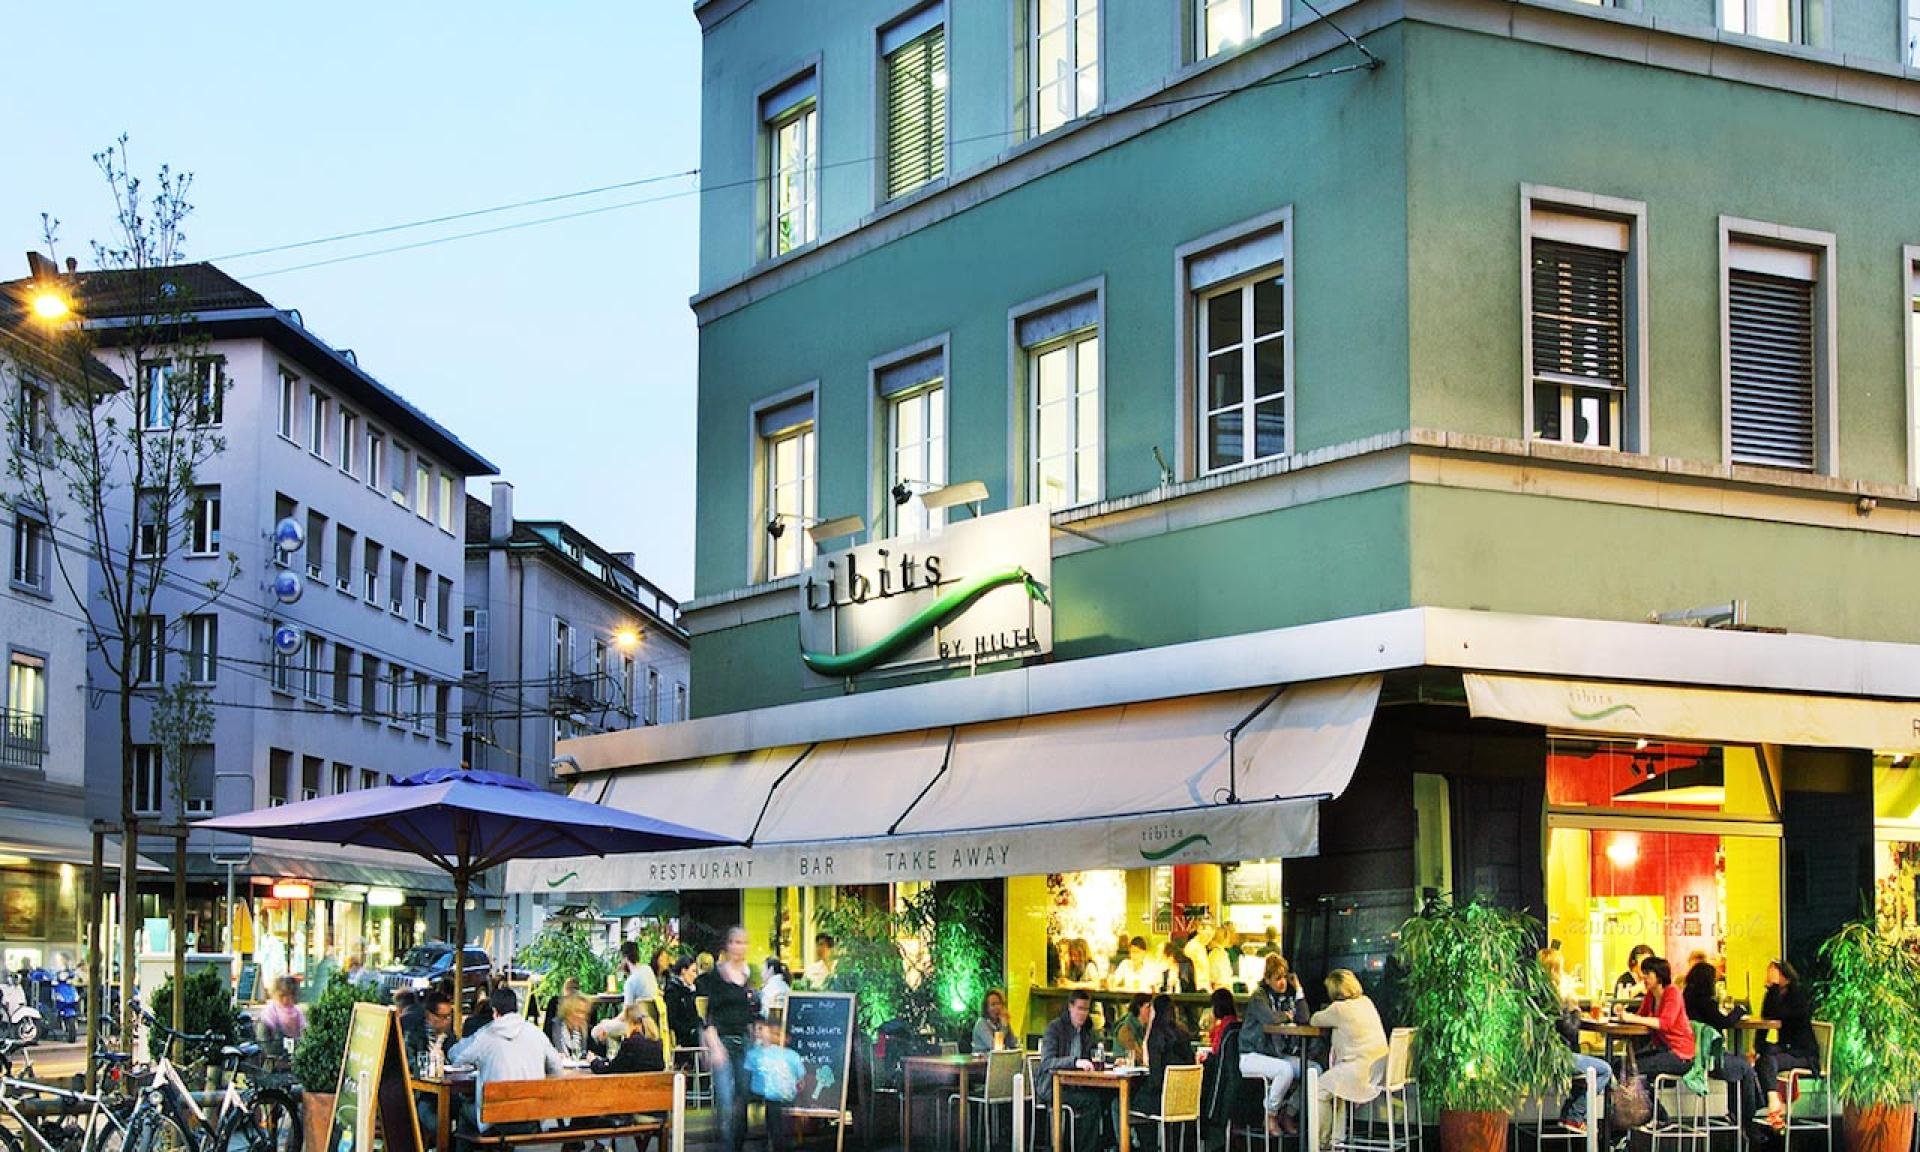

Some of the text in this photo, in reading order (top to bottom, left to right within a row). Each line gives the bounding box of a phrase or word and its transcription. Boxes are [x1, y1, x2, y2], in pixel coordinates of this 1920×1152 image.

[804, 548, 943, 610] tibits
[939, 627, 1039, 659] BY HILTL
[1142, 824, 1184, 841] tibits
[649, 846, 1010, 881] RESTAURANT BAR TAKE AWAY
